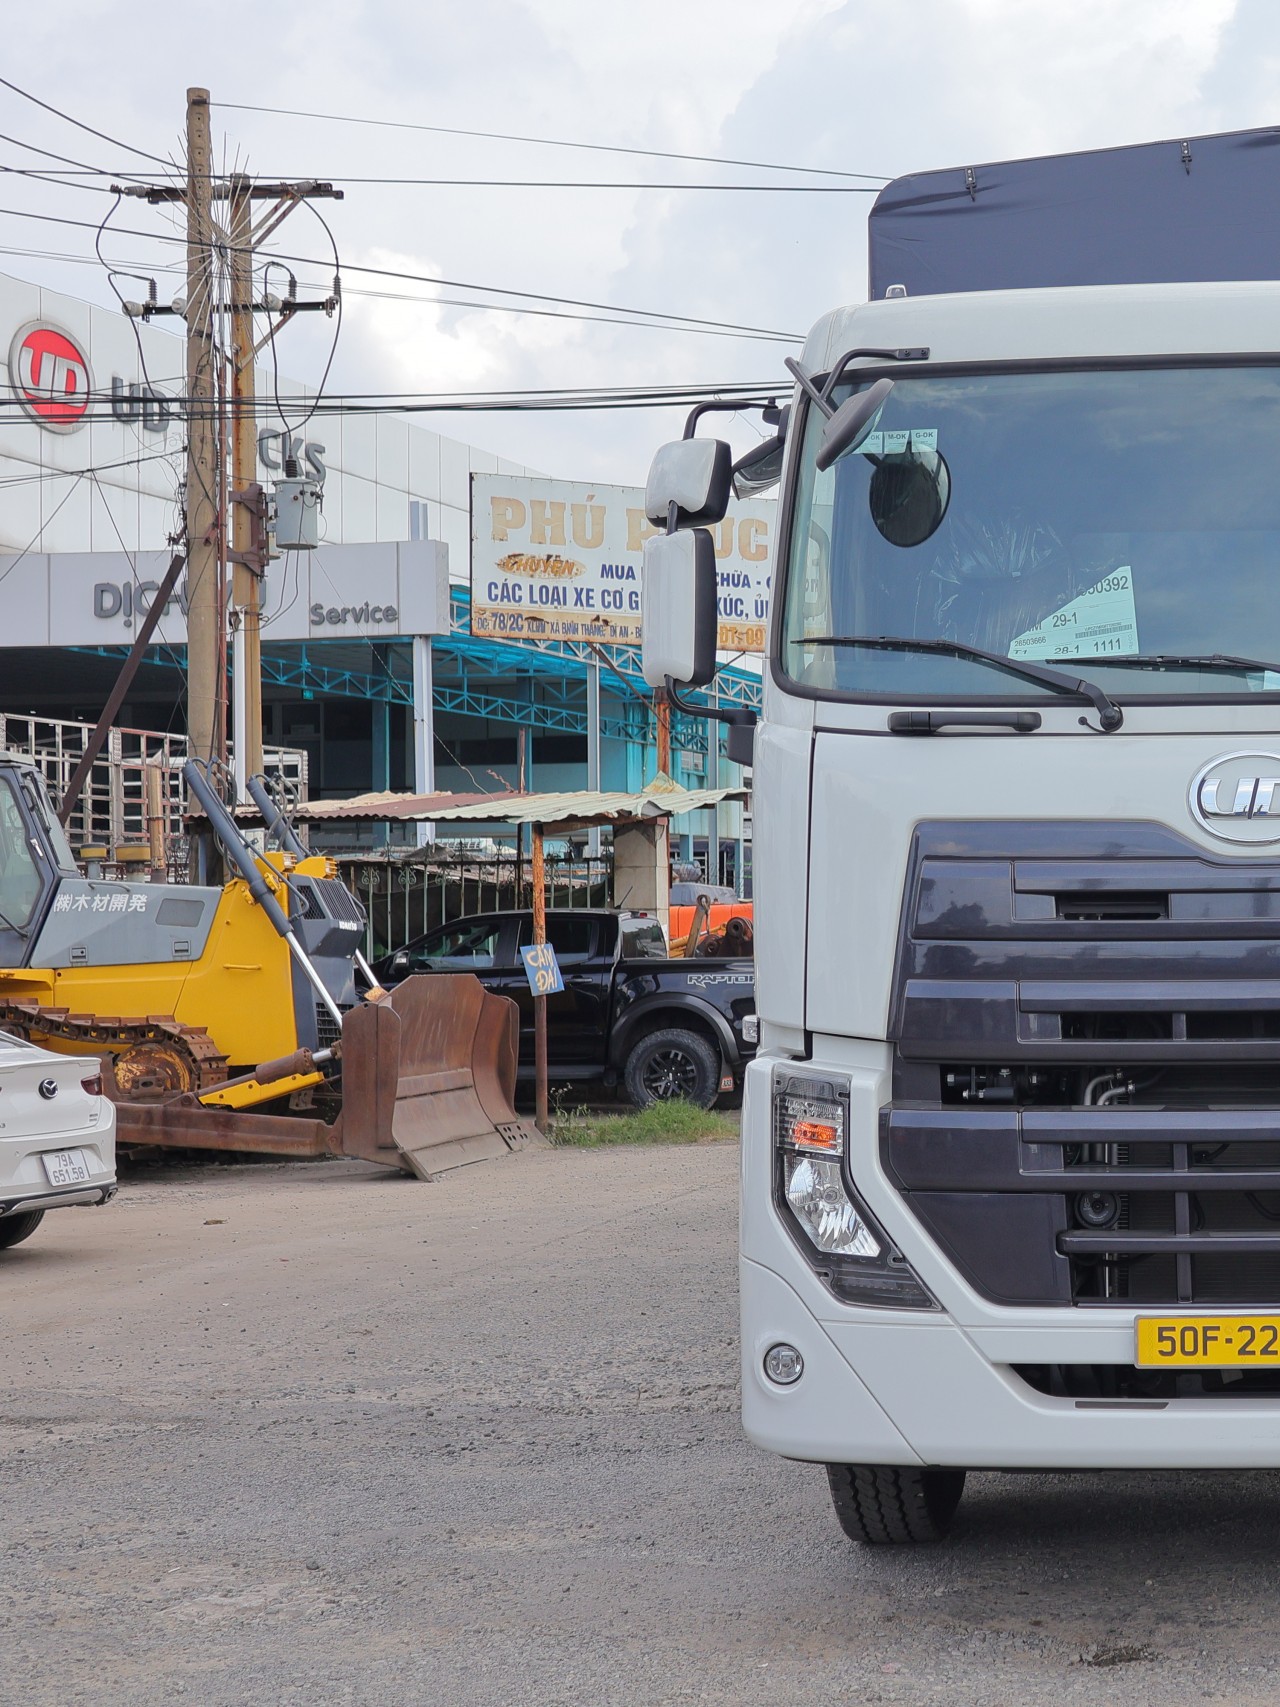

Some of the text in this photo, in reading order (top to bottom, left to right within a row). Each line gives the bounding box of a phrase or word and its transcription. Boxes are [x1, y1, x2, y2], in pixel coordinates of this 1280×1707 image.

[490, 494, 607, 549] PHÚ
[600, 563, 636, 580] MUA
[488, 578, 523, 604] CÁC
[573, 587, 595, 608] XE
[310, 600, 400, 626] Service
